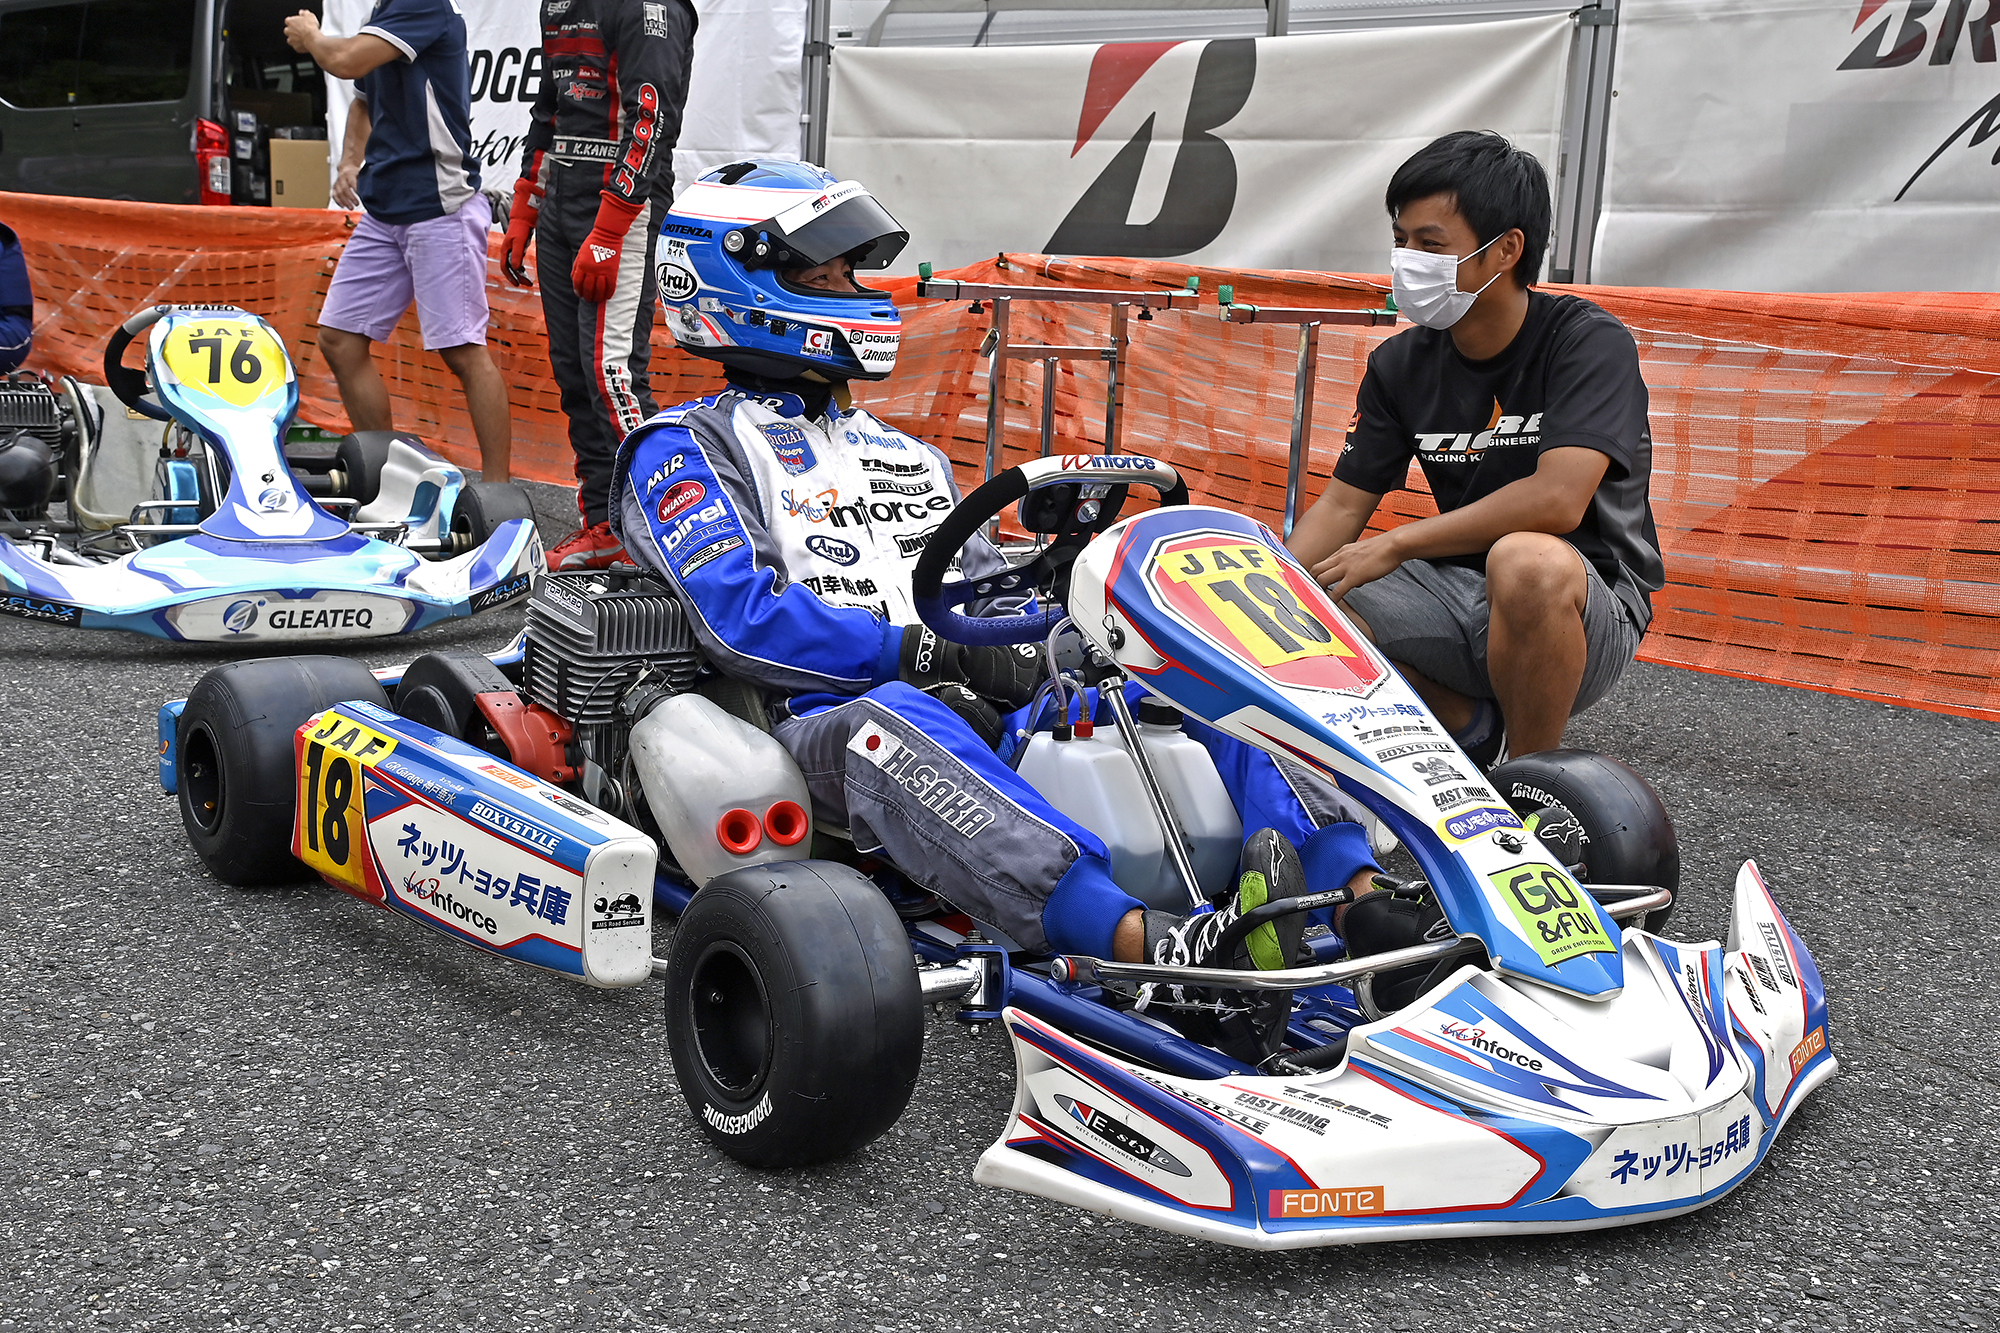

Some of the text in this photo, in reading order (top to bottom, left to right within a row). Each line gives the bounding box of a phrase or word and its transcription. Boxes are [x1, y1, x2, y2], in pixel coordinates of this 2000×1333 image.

[647, 27, 665, 37] TWO
[471, 47, 542, 102] DGE
[664, 224, 713, 239] POTENZA
[659, 266, 691, 290] Arai
[865, 334, 896, 344] OGURA
[188, 338, 262, 384] 76
[860, 431, 907, 450] YAMAHA
[1488, 435, 1542, 446] GINEER
[858, 458, 925, 473] TIGRE
[1062, 454, 1156, 470] Winforce
[1421, 453, 1466, 462] RACING
[870, 481, 933, 494] BOXYSTYLE
[661, 497, 728, 554] birel
[671, 521, 736, 563] PACIFIC
[681, 537, 741, 573] FREELINE
[814, 539, 852, 560] Arai
[1180, 548, 1265, 575] JAF
[545, 582, 562, 596] TOP
[562, 591, 583, 608] LABO
[269, 608, 373, 631] GLEATEQ
[1207, 572, 1332, 654] 18
[1322, 704, 1425, 726] ネッツトヨタ兵庫
[315, 719, 385, 758] JAF
[1354, 725, 1434, 741] TIGRE
[1376, 743, 1453, 760] BOXYSTYLE
[385, 761, 400, 772] GR
[397, 766, 424, 787] Garage
[423, 780, 457, 806] 神戸垂水
[879, 747, 994, 839] H.SAKA
[1432, 786, 1491, 807] EAST WING
[303, 741, 352, 866] 18
[1511, 782, 1591, 846] BRIDGEONE
[471, 801, 561, 851] BOXYSTYLE
[397, 822, 573, 926] ネッツトヨタ兵庫
[403, 876, 427, 897] Super
[1509, 870, 1579, 915] GO
[1537, 911, 1599, 943] &FUN
[1551, 944, 1572, 956] GREEN
[1760, 922, 1793, 986] BOXYSTYLE
[1440, 1023, 1469, 1041] Super
[1792, 1032, 1822, 1072] FONTE
[703, 1090, 773, 1135] BRIDGESTONE
[1126, 1068, 1269, 1132] BOXYSTYLE
[1234, 1100, 1244, 1108] Car
[1235, 1092, 1331, 1130] EAST WING
[1283, 1086, 1393, 1124] TIGRE
[1283, 1092, 1389, 1130] RACING KART ENGINEERING
[1074, 1125, 1155, 1175] NETZ ENTERTAINMENT STYLE
[1610, 1114, 1750, 1185] ネッツトヨタ兵庫
[1283, 1190, 1375, 1214] FONTE
